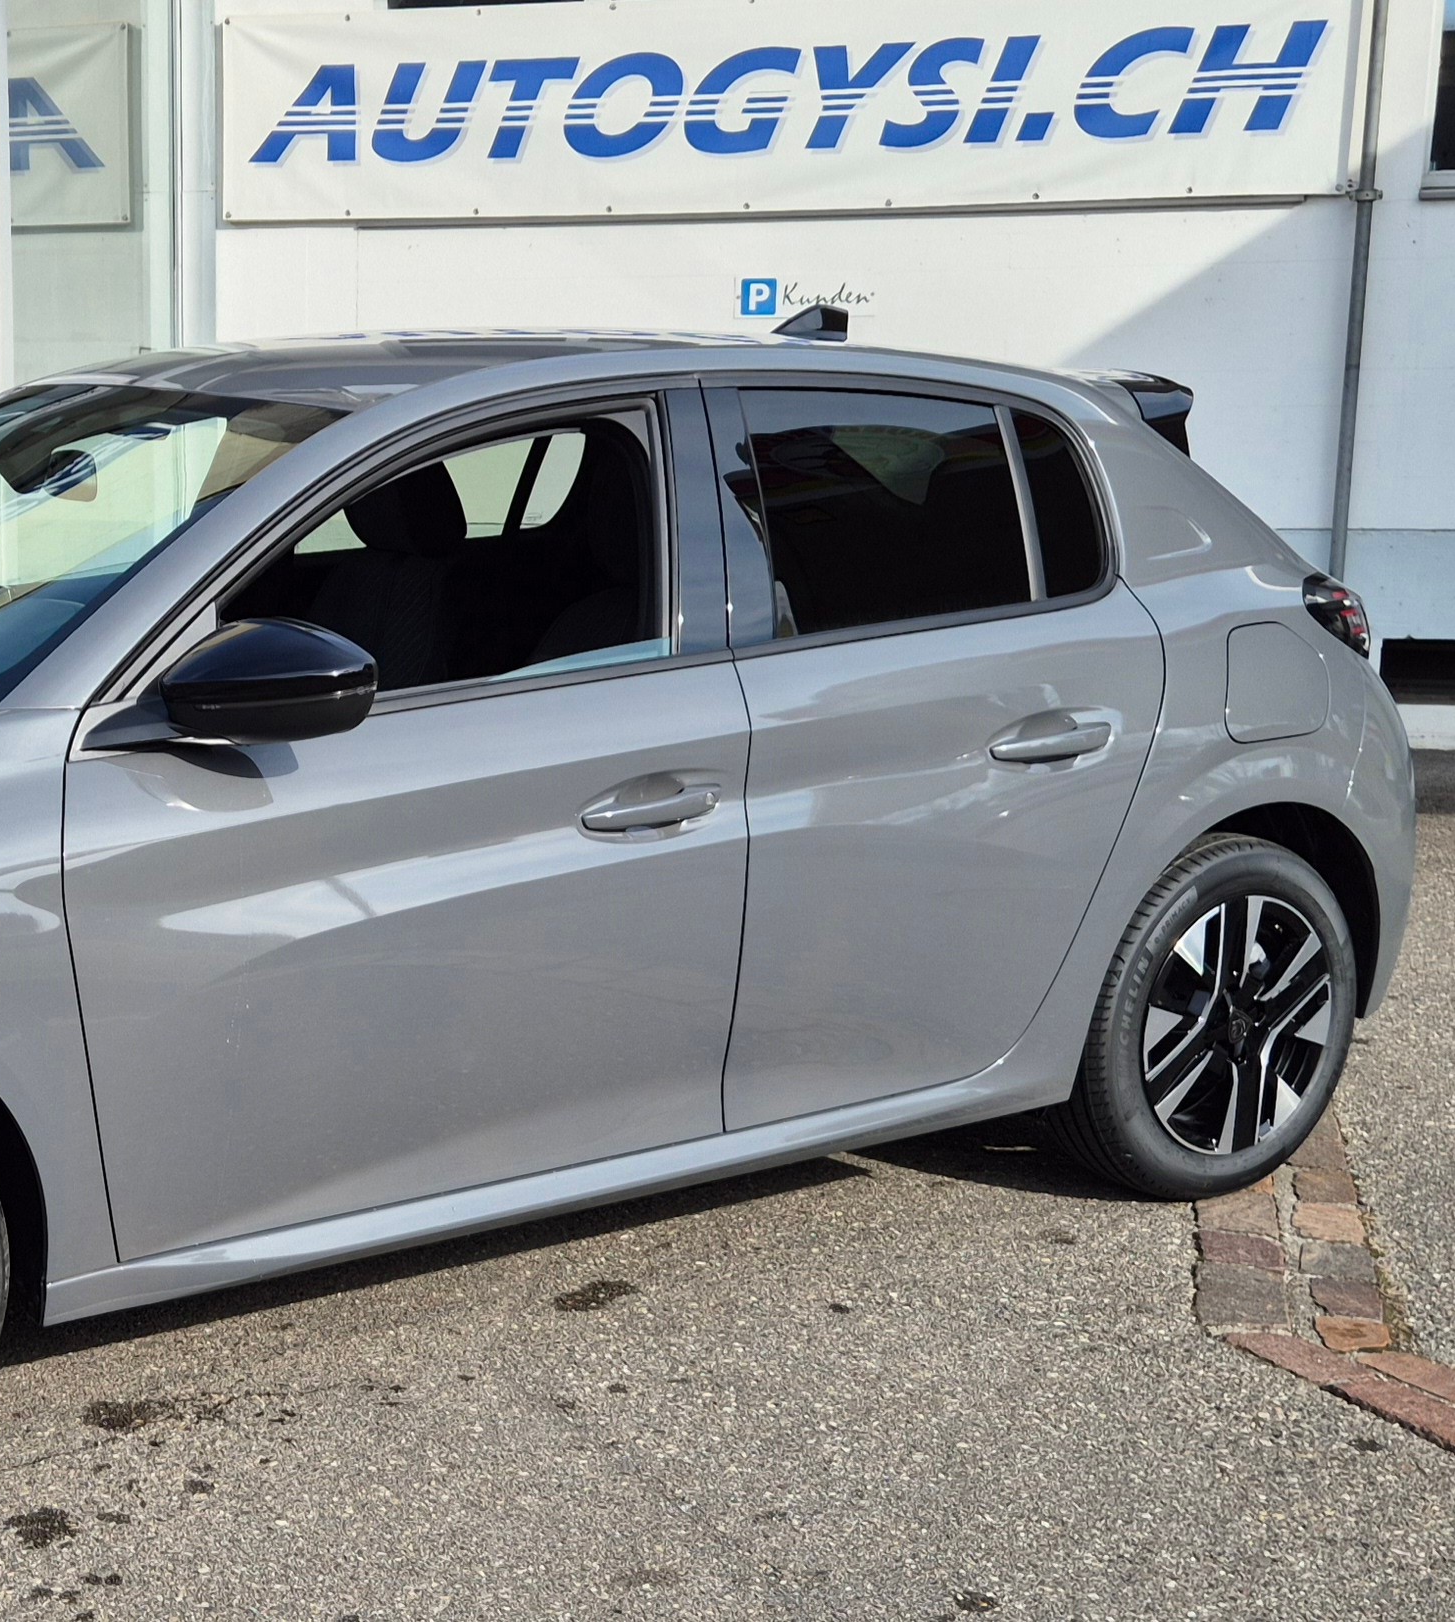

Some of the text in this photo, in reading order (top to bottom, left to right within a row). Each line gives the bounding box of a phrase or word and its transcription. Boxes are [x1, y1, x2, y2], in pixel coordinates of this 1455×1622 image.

[248, 20, 1329, 164] AUTOGYSI.CH
[748, 282, 870, 311] P Kunden
